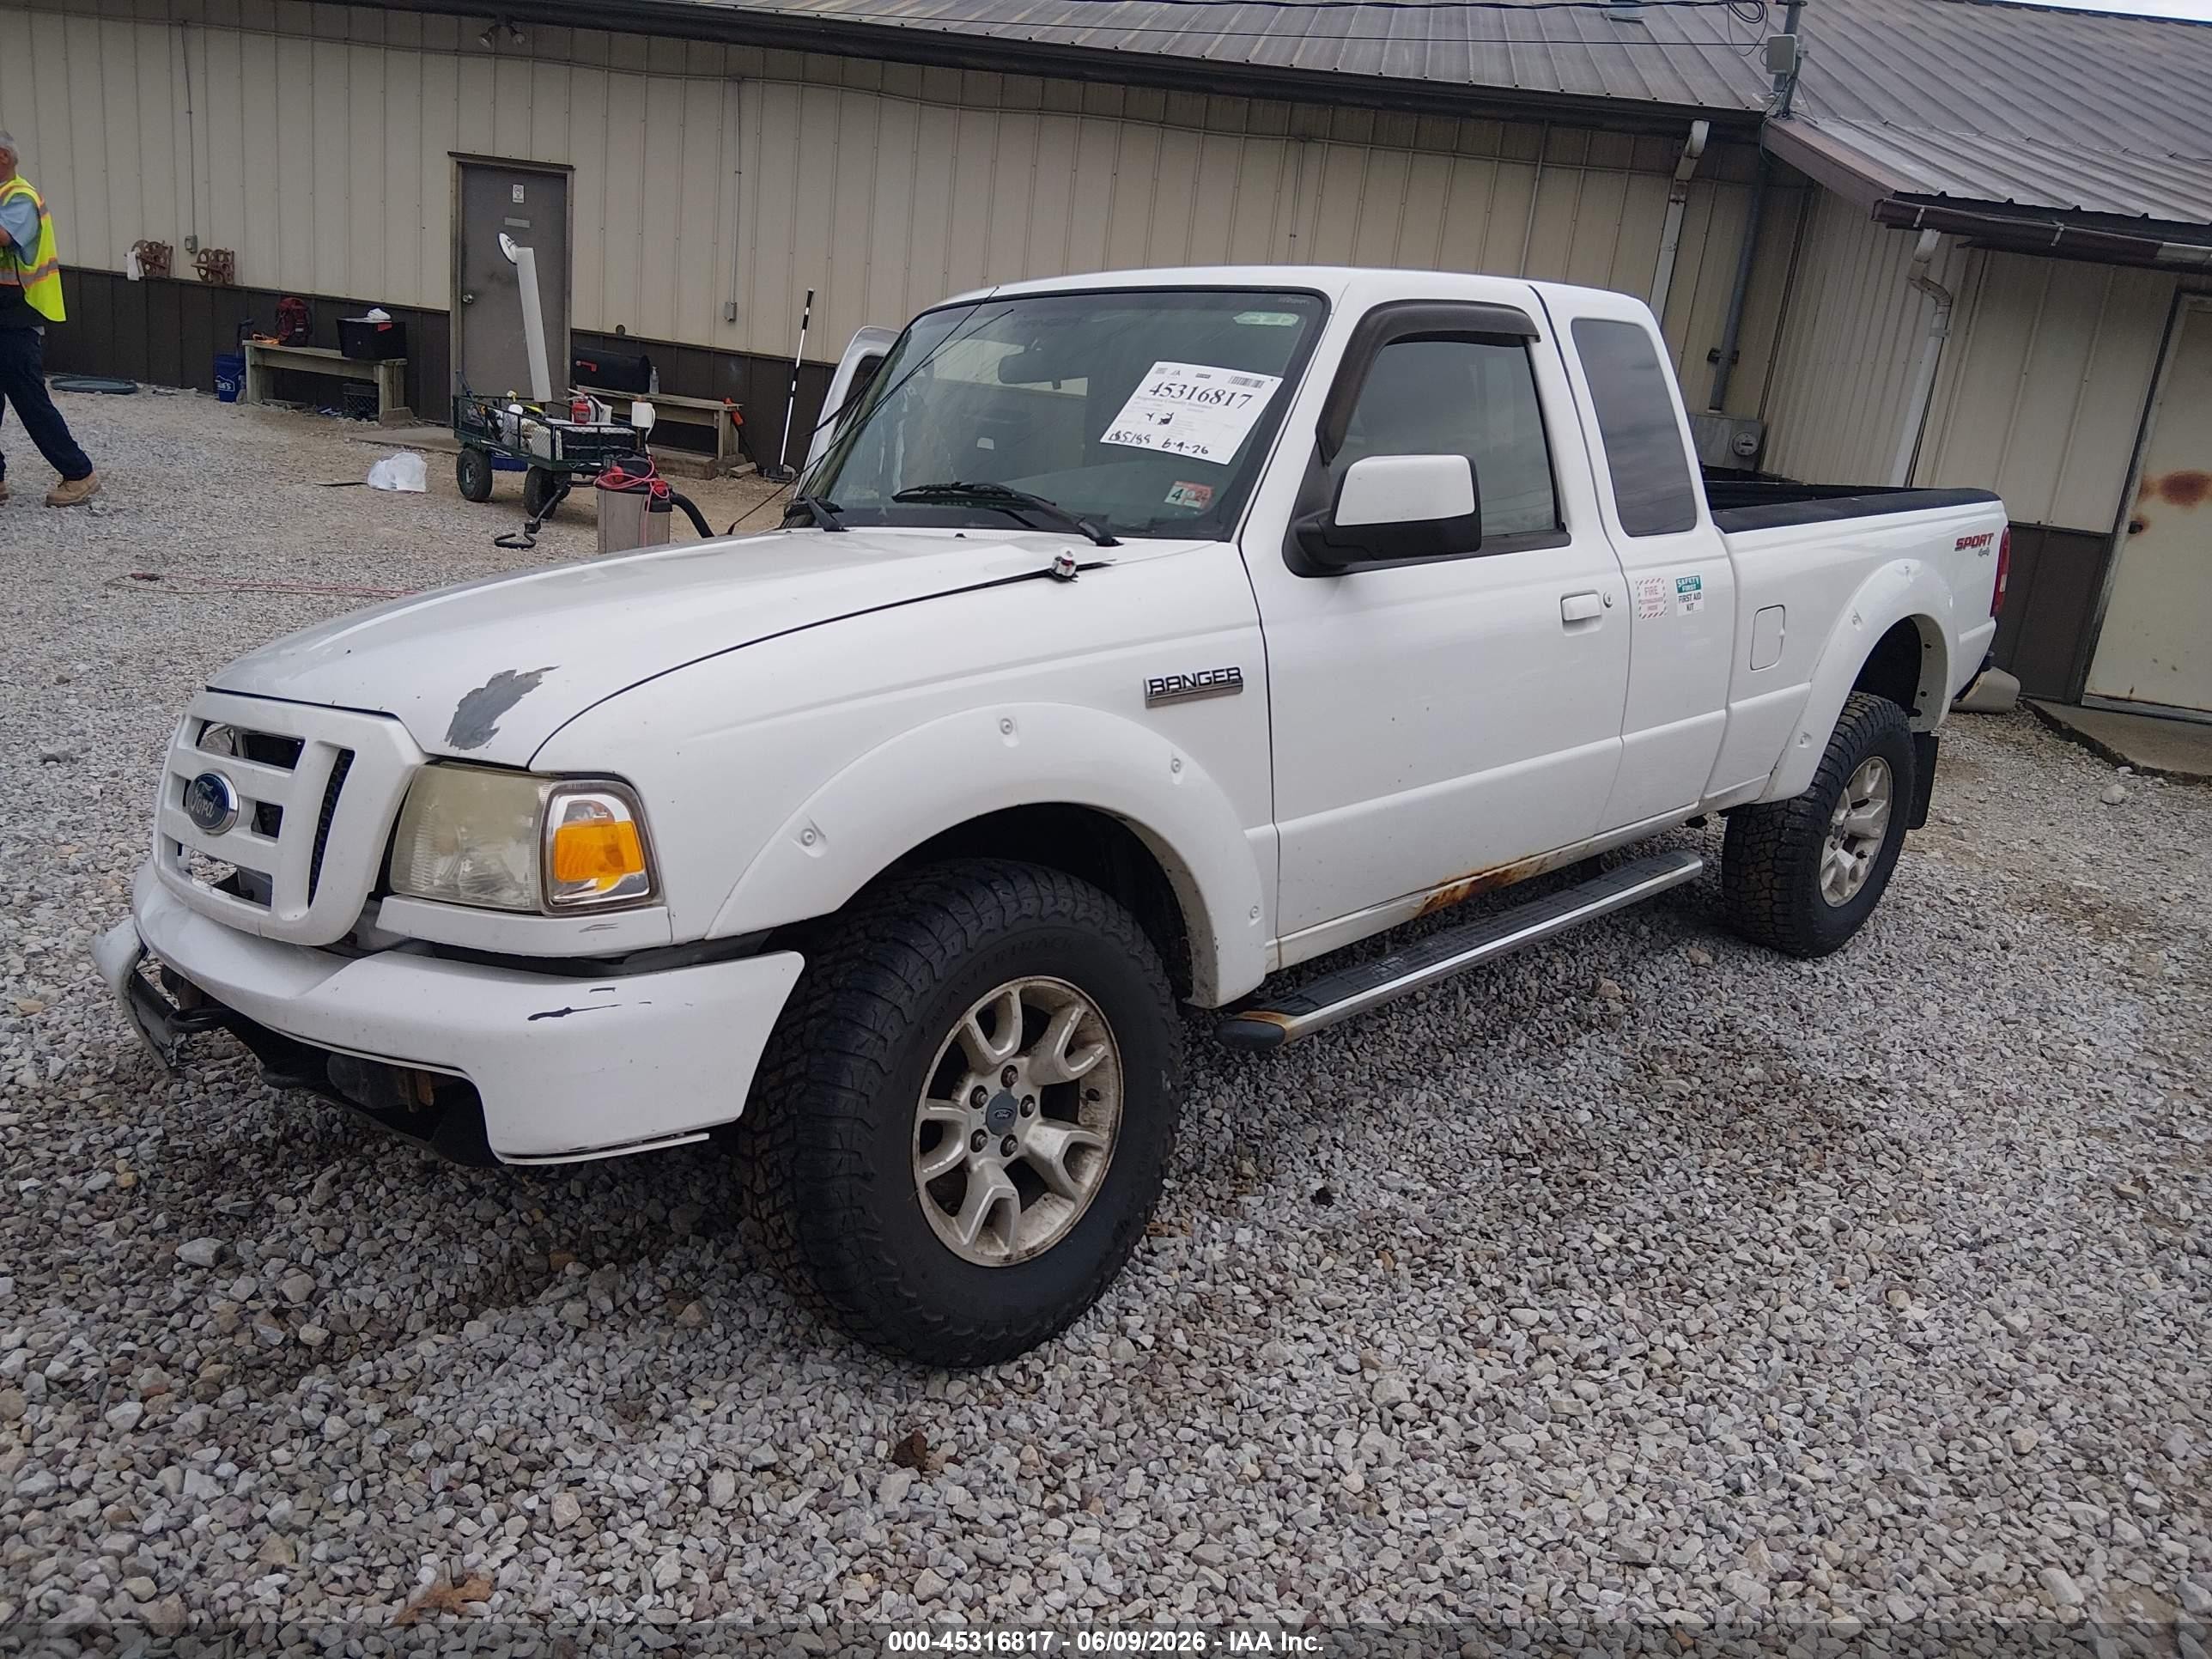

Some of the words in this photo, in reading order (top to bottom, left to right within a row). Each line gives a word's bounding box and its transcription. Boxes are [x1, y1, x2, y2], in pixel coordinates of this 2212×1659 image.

[1149, 381, 1254, 410] 45316817
[1171, 488, 1184, 501] 4
[1954, 532, 1994, 551] SPORT
[1644, 586, 1659, 597] FIRE
[1678, 594, 1692, 605] FIRST
[1692, 592, 1702, 601] AID
[1686, 603, 1695, 611] KIT
[1147, 666, 1243, 694] RANGER
[191, 781, 219, 818] Ford
